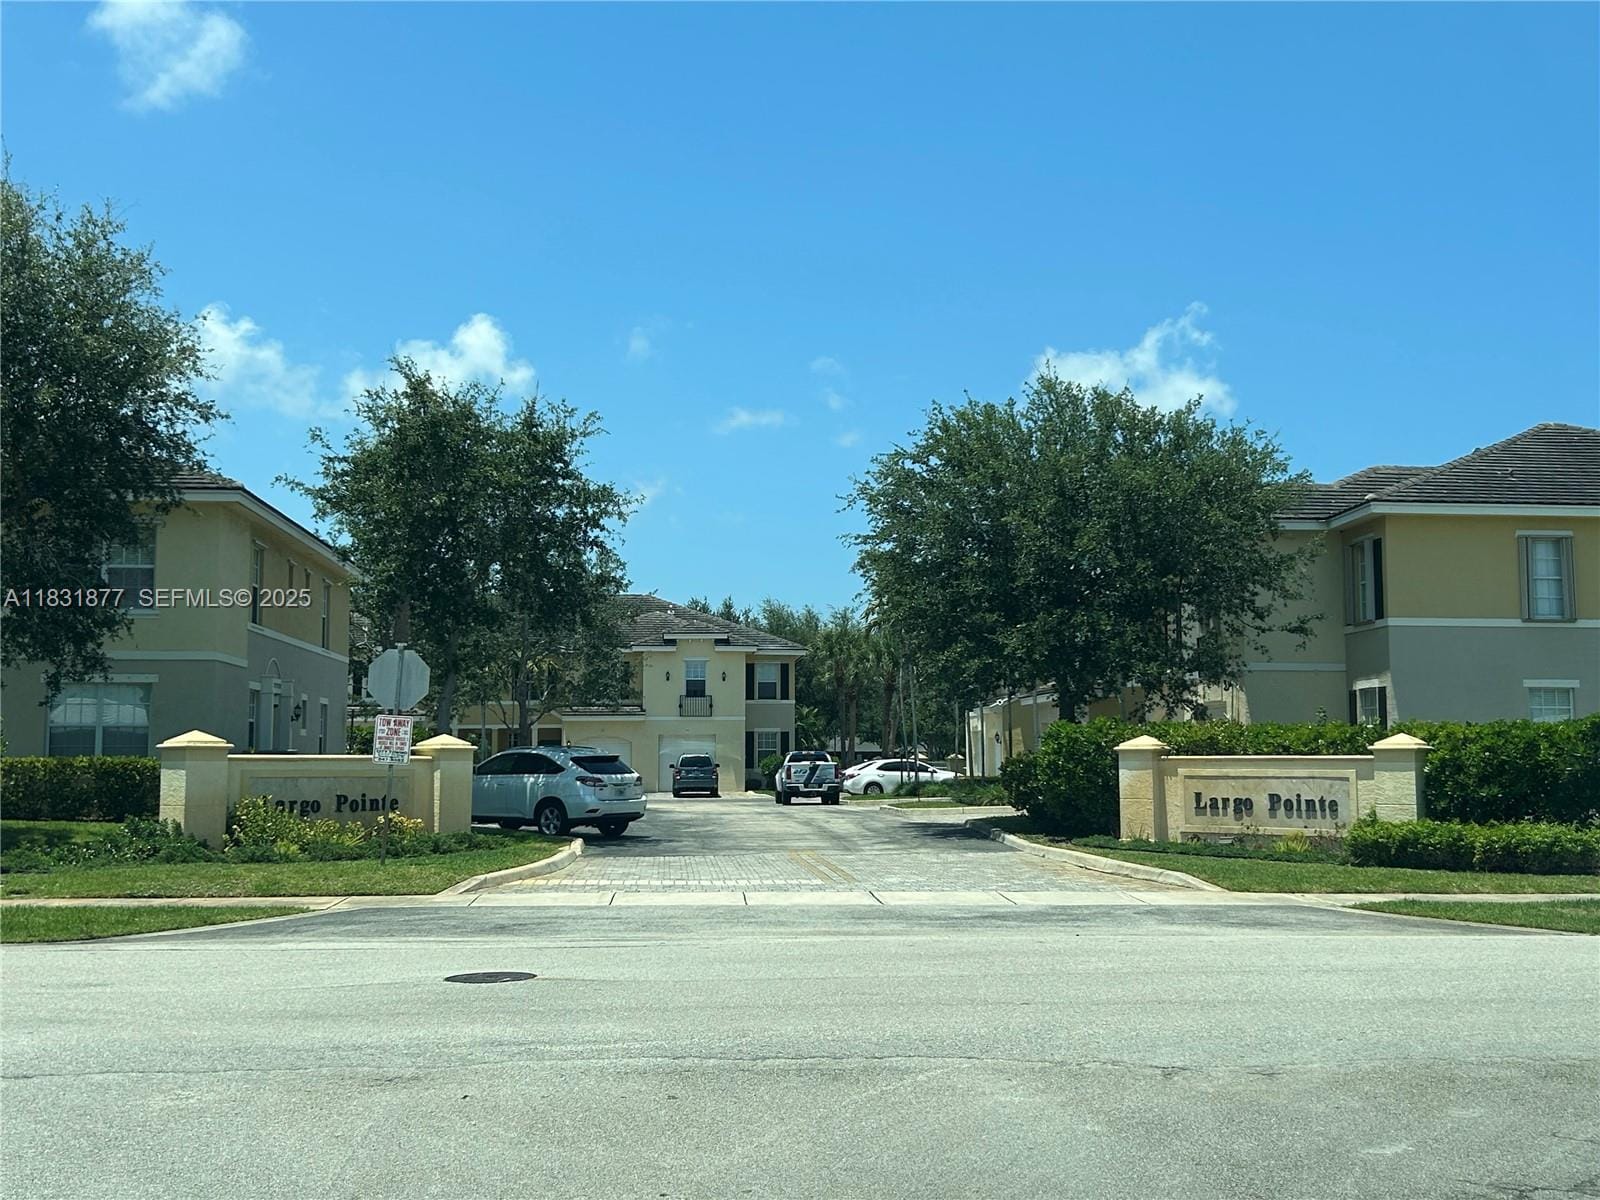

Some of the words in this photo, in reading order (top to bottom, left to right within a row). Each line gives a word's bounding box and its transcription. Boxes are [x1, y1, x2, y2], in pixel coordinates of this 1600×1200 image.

[379, 718, 392, 727] TOW
[393, 719, 410, 728] AWAY
[386, 728, 401, 736] ZONE
[263, 795, 321, 817] argo
[1193, 791, 1254, 814] Largo
[1267, 793, 1339, 813] Pointe
